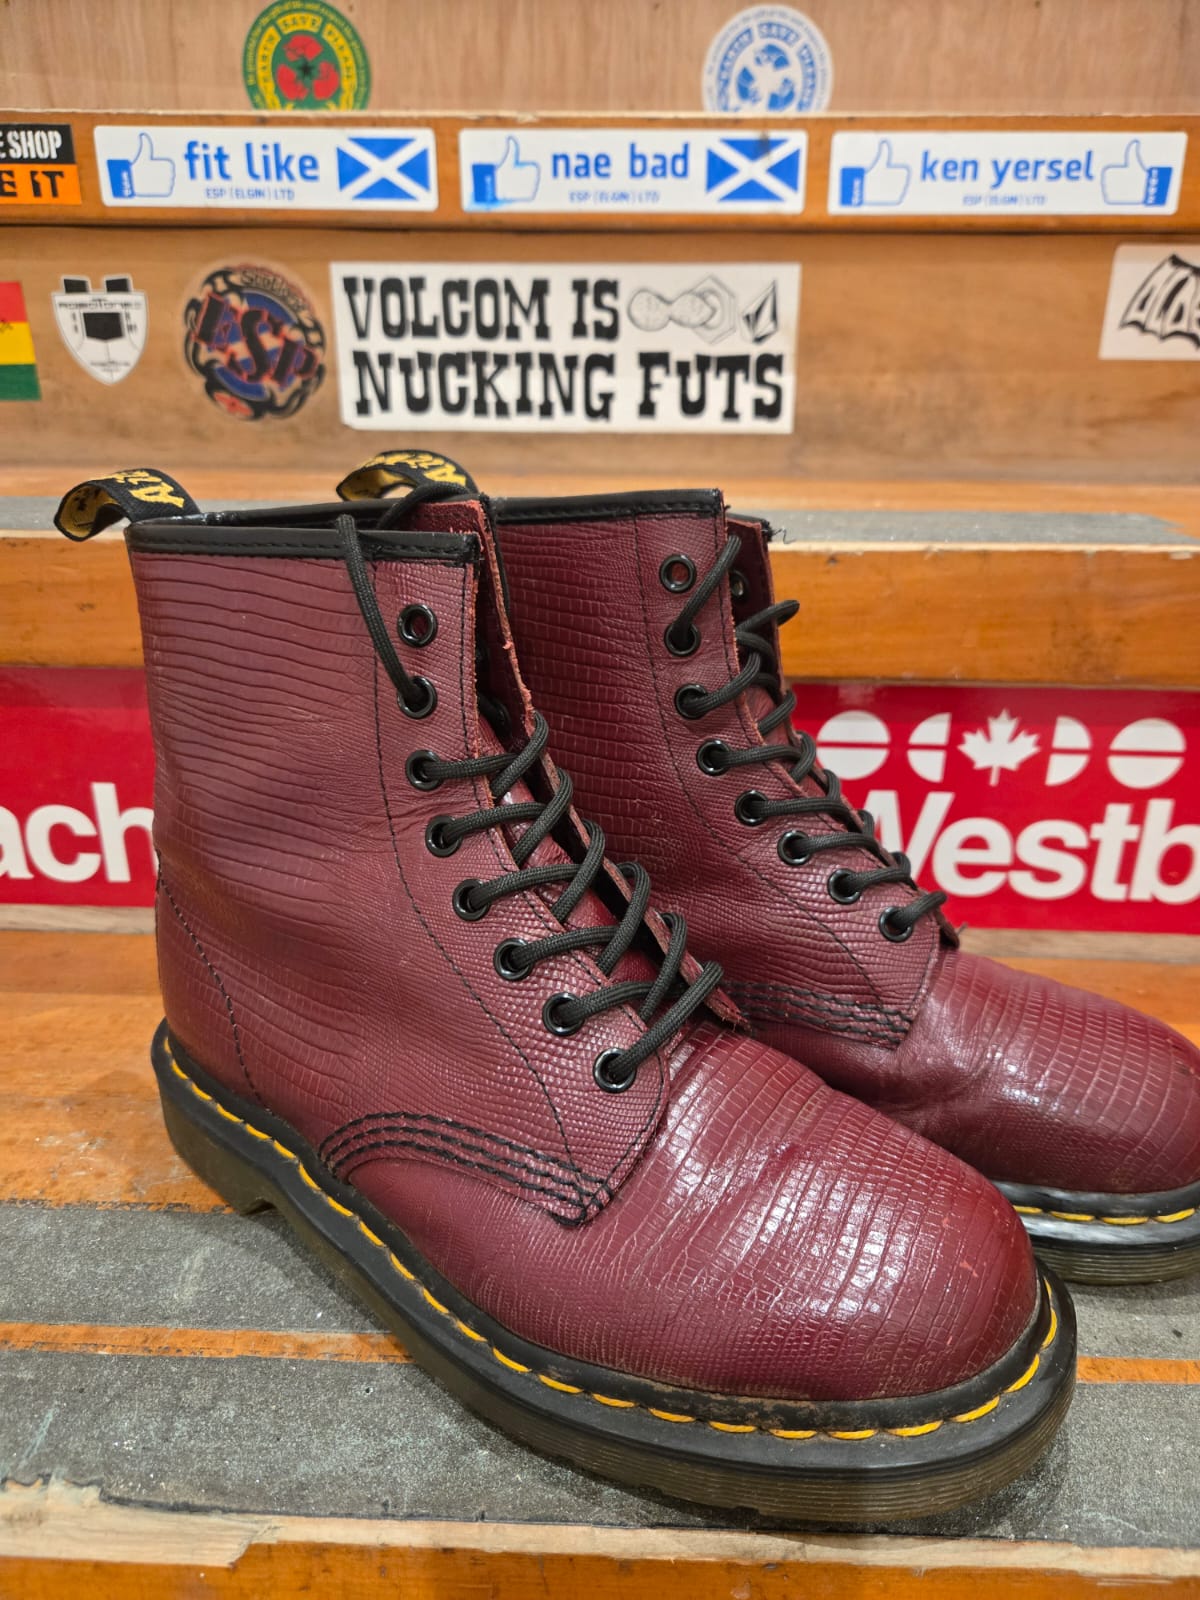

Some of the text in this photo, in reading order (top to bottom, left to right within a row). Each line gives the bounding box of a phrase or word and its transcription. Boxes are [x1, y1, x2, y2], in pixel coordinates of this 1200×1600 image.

[6, 129, 62, 159] SHOP
[184, 140, 319, 181] fit like
[552, 142, 688, 178] nae bad
[30, 170, 64, 198] IT
[920, 149, 1094, 190] ken yersel
[343, 275, 620, 341] VOLCOM IS
[352, 350, 785, 421] NUCKING FUTS
